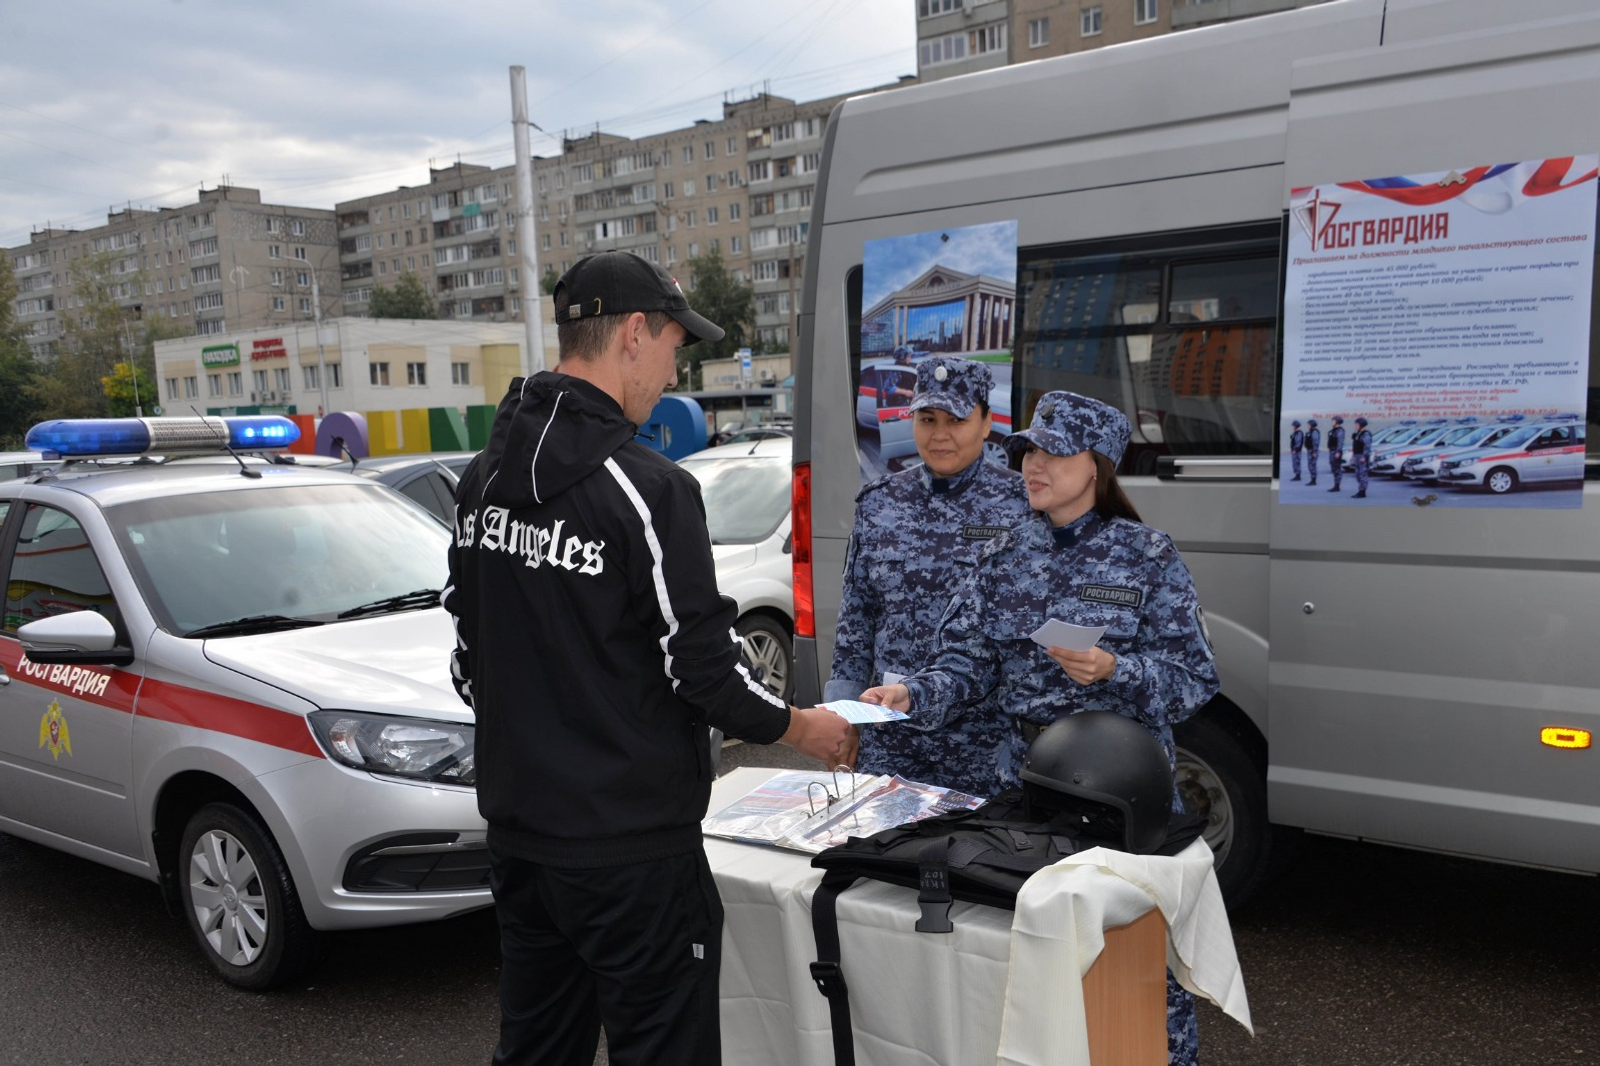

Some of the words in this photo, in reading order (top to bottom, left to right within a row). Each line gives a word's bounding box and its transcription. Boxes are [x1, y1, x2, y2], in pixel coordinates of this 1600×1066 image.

[1292, 255, 1346, 266] Приглашаем
[1347, 253, 1358, 261] на
[1359, 249, 1410, 260] должности
[1411, 245, 1457, 255] младшего
[1457, 238, 1544, 251] начальствующего
[1545, 234, 1588, 244] состава
[480, 505, 605, 576] Angeles
[967, 528, 1008, 536] РОСГВАРД
[1085, 588, 1136, 602] РОСГВАРДИЯ
[17, 655, 111, 696] РОСГВАРДИЯ
